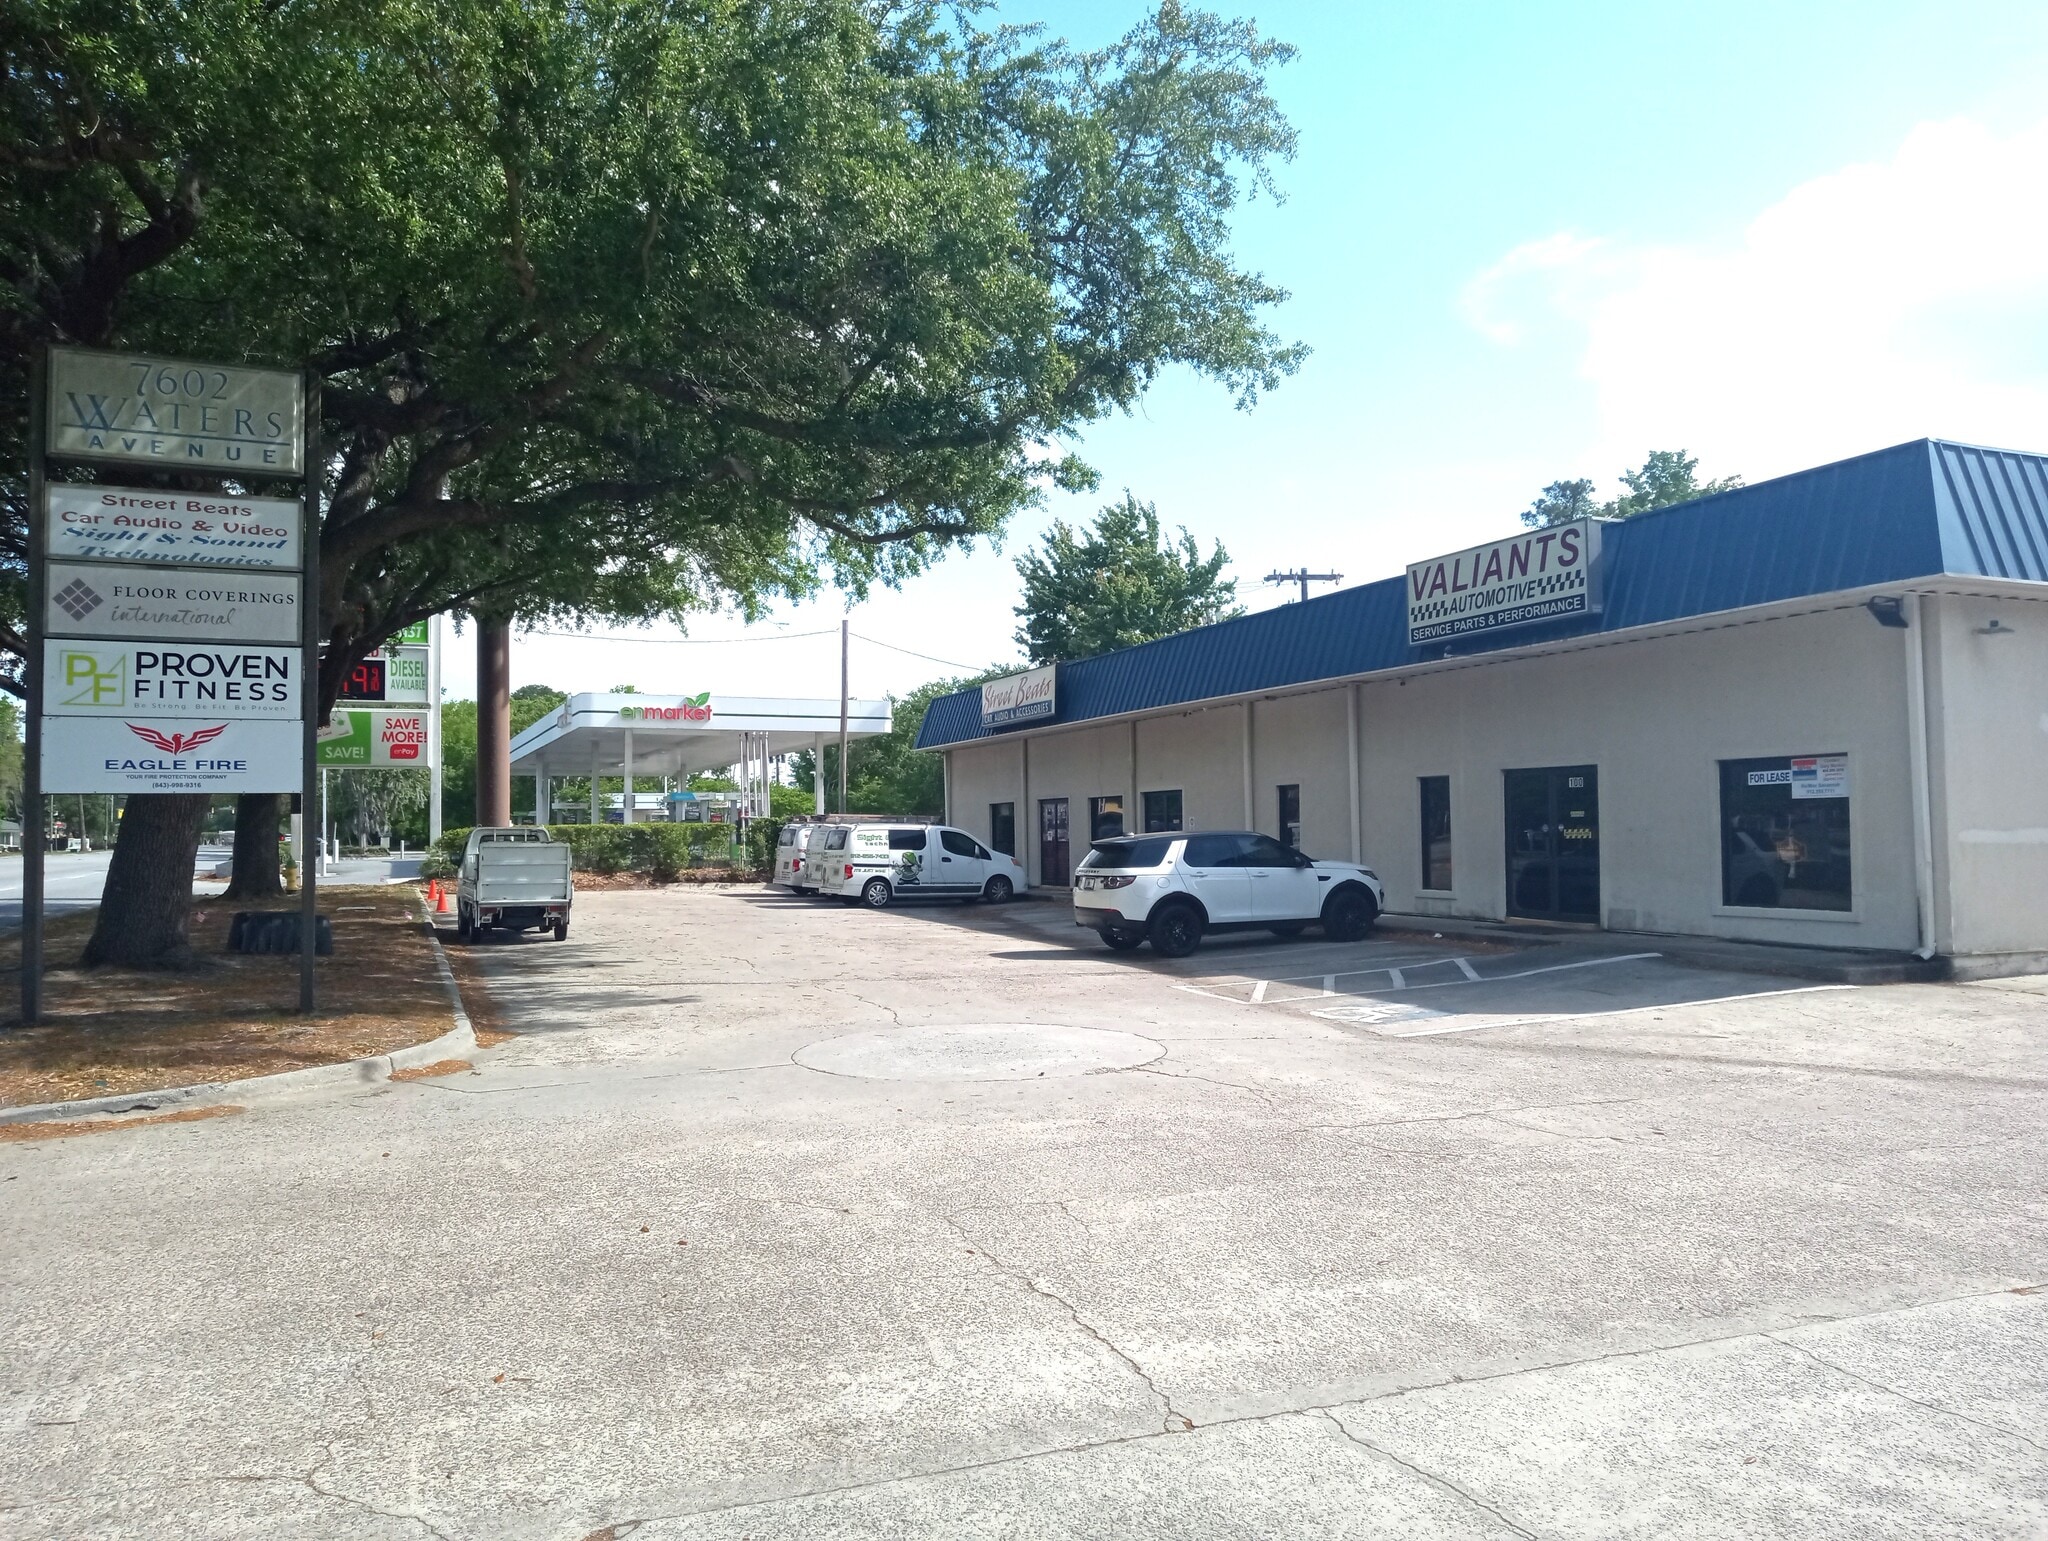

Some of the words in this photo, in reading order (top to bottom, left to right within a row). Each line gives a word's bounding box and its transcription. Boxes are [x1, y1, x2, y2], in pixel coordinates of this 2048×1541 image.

[130, 362, 229, 400] 7602
[65, 391, 283, 438] WATERS
[88, 434, 277, 464] AVENUE
[101, 494, 177, 512] Street
[186, 500, 252, 517] Beats
[61, 511, 104, 525] Car
[113, 515, 182, 530] Audio
[191, 520, 214, 532] &
[223, 522, 288, 537] Video
[61, 526, 148, 542] Sight
[155, 533, 182, 545] &
[189, 534, 288, 550] Sound
[77, 545, 275, 567] Technologies
[1412, 527, 1581, 601] VALIANTS
[113, 586, 177, 600] FLOOR
[186, 589, 295, 605] COVERINGS
[1449, 579, 1537, 615] AUTOMOTIVE
[110, 605, 236, 625] international
[1413, 623, 1452, 641] SERVICE
[1454, 614, 1486, 632] PARTS
[1488, 614, 1496, 626] &
[1498, 596, 1582, 624] PERFORMANCE
[135, 651, 289, 680] PROVEN
[390, 660, 426, 677] DIESEL
[134, 679, 289, 702] FITNESS
[390, 679, 426, 690] AVAILABLE
[983, 685, 1014, 715] Street
[1015, 676, 1052, 707] Beats
[620, 703, 713, 721] enmarket
[1016, 702, 1049, 717] ACCESSORIES
[385, 718, 420, 730] SAVE
[381, 731, 428, 743] MORE!
[325, 746, 364, 759] SAVE!
[104, 759, 187, 770] EAGLE
[195, 760, 248, 771] FIRE
[1750, 773, 1765, 784] FOR
[1766, 771, 1790, 783] LEASE
[857, 834, 884, 842] Sight
